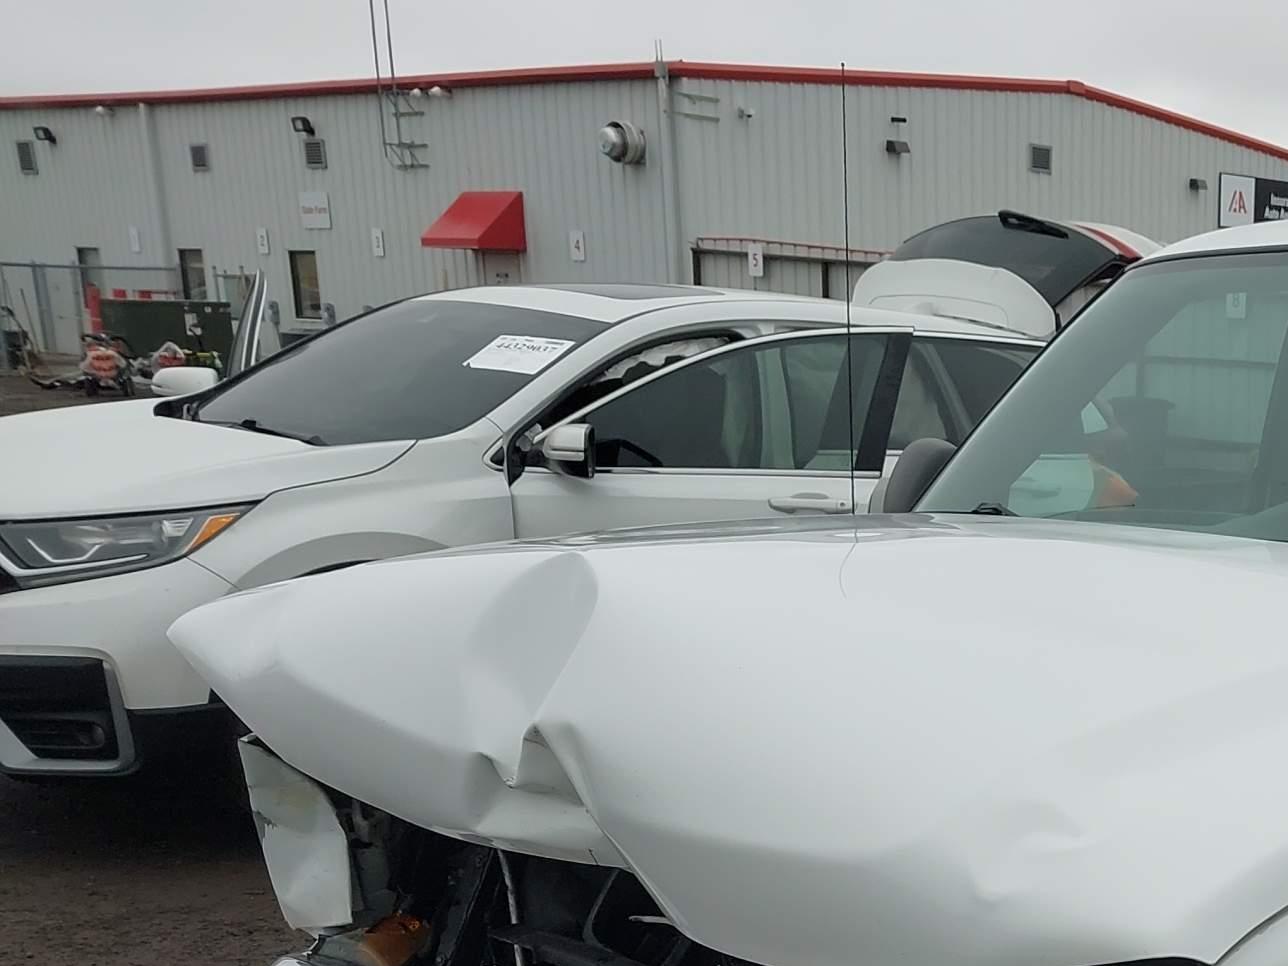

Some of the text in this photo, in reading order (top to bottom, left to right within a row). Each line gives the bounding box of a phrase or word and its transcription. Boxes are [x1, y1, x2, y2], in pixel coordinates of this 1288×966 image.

[1263, 204, 1280, 220] Auto
[574, 239, 581, 254] 4
[752, 252, 760, 268] 5
[1231, 292, 1241, 308] 8
